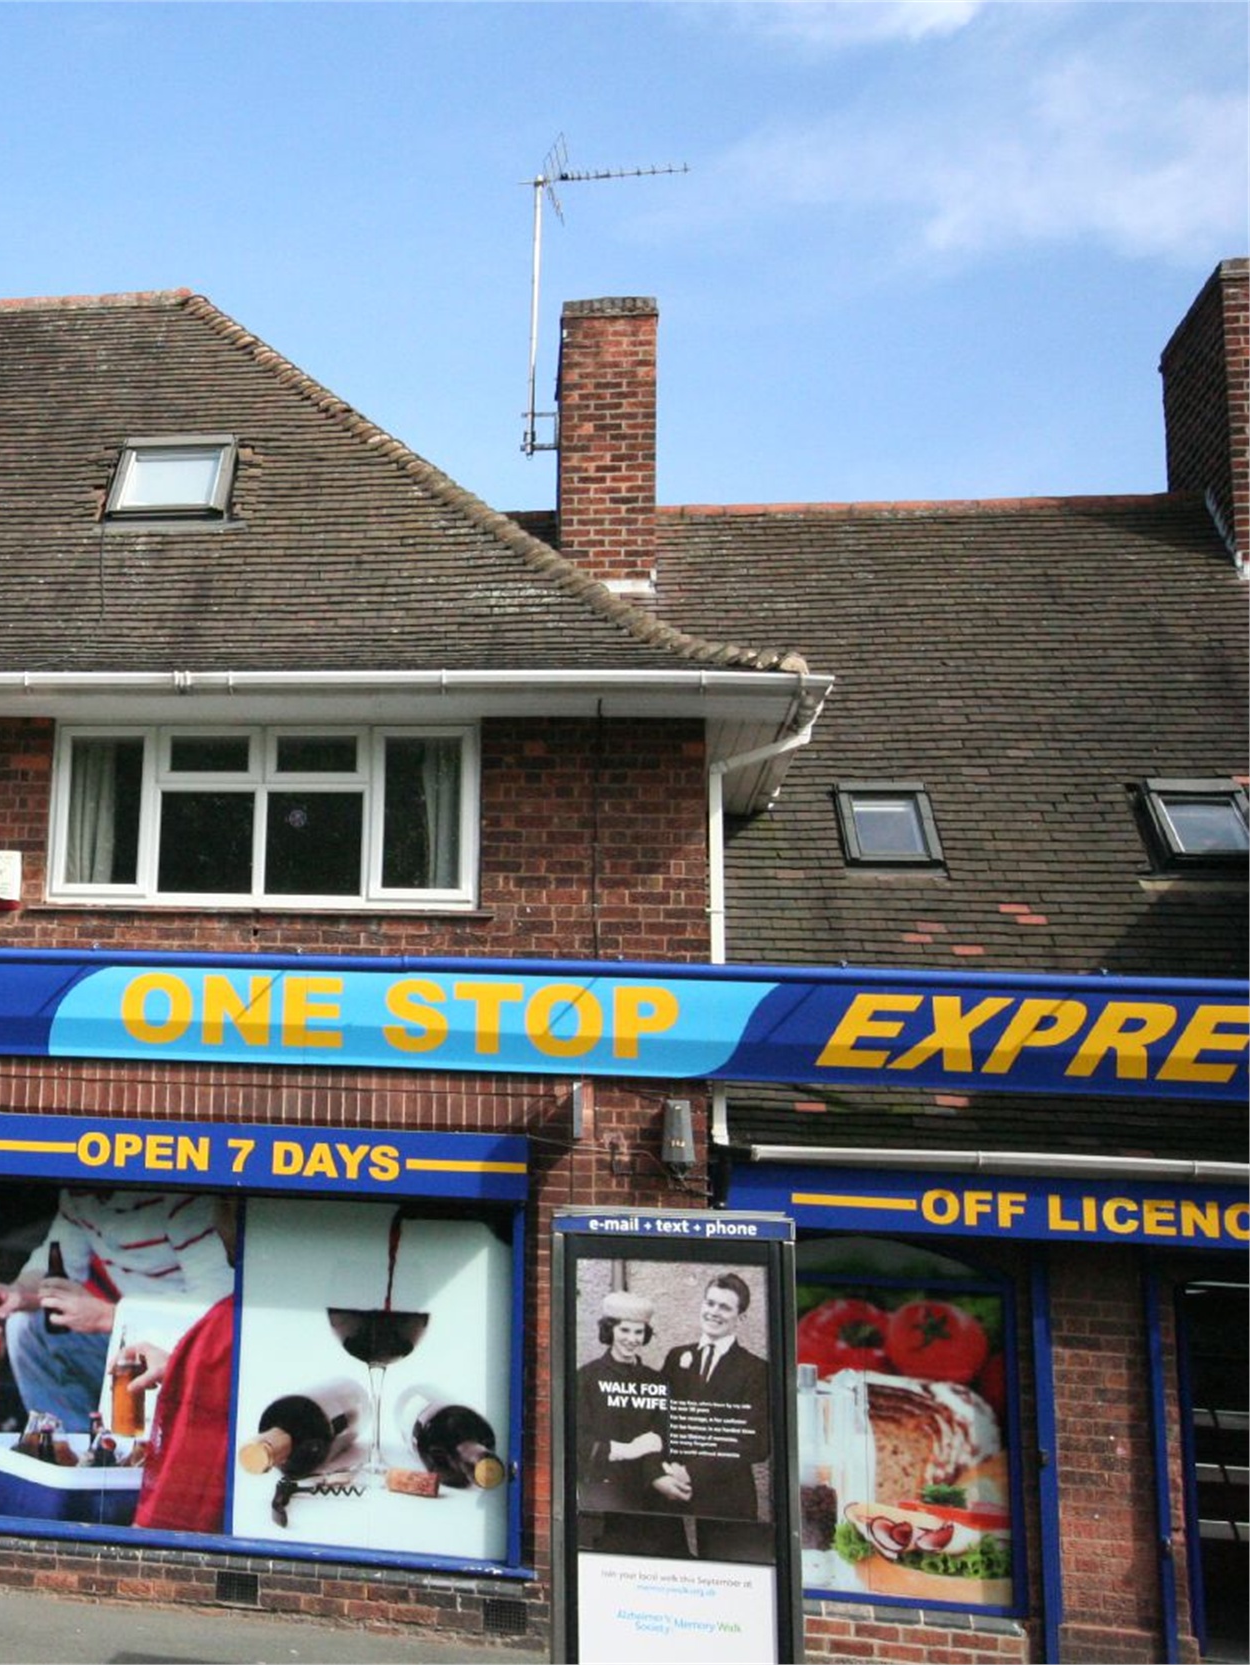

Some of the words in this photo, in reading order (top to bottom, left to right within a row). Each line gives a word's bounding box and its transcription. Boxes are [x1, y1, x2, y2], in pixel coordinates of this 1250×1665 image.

[120, 971, 344, 1048] ONE
[382, 979, 680, 1059] STOP
[816, 993, 1249, 1083] EXPRE
[77, 1132, 209, 1171] OPEN
[227, 1139, 255, 1173] 7
[272, 1141, 400, 1181] DAYS
[589, 1216, 639, 1231] e-mail
[655, 1219, 690, 1233] text
[706, 1218, 757, 1237] phone
[921, 1189, 1027, 1229] OFF
[1048, 1195, 1249, 1241] LICENC
[598, 1380, 638, 1395] WALK
[640, 1383, 667, 1396] FOR
[607, 1395, 629, 1408] MY
[631, 1396, 668, 1410] WIFE
[674, 1618, 716, 1633] Memory
[717, 1620, 741, 1633] Walk
